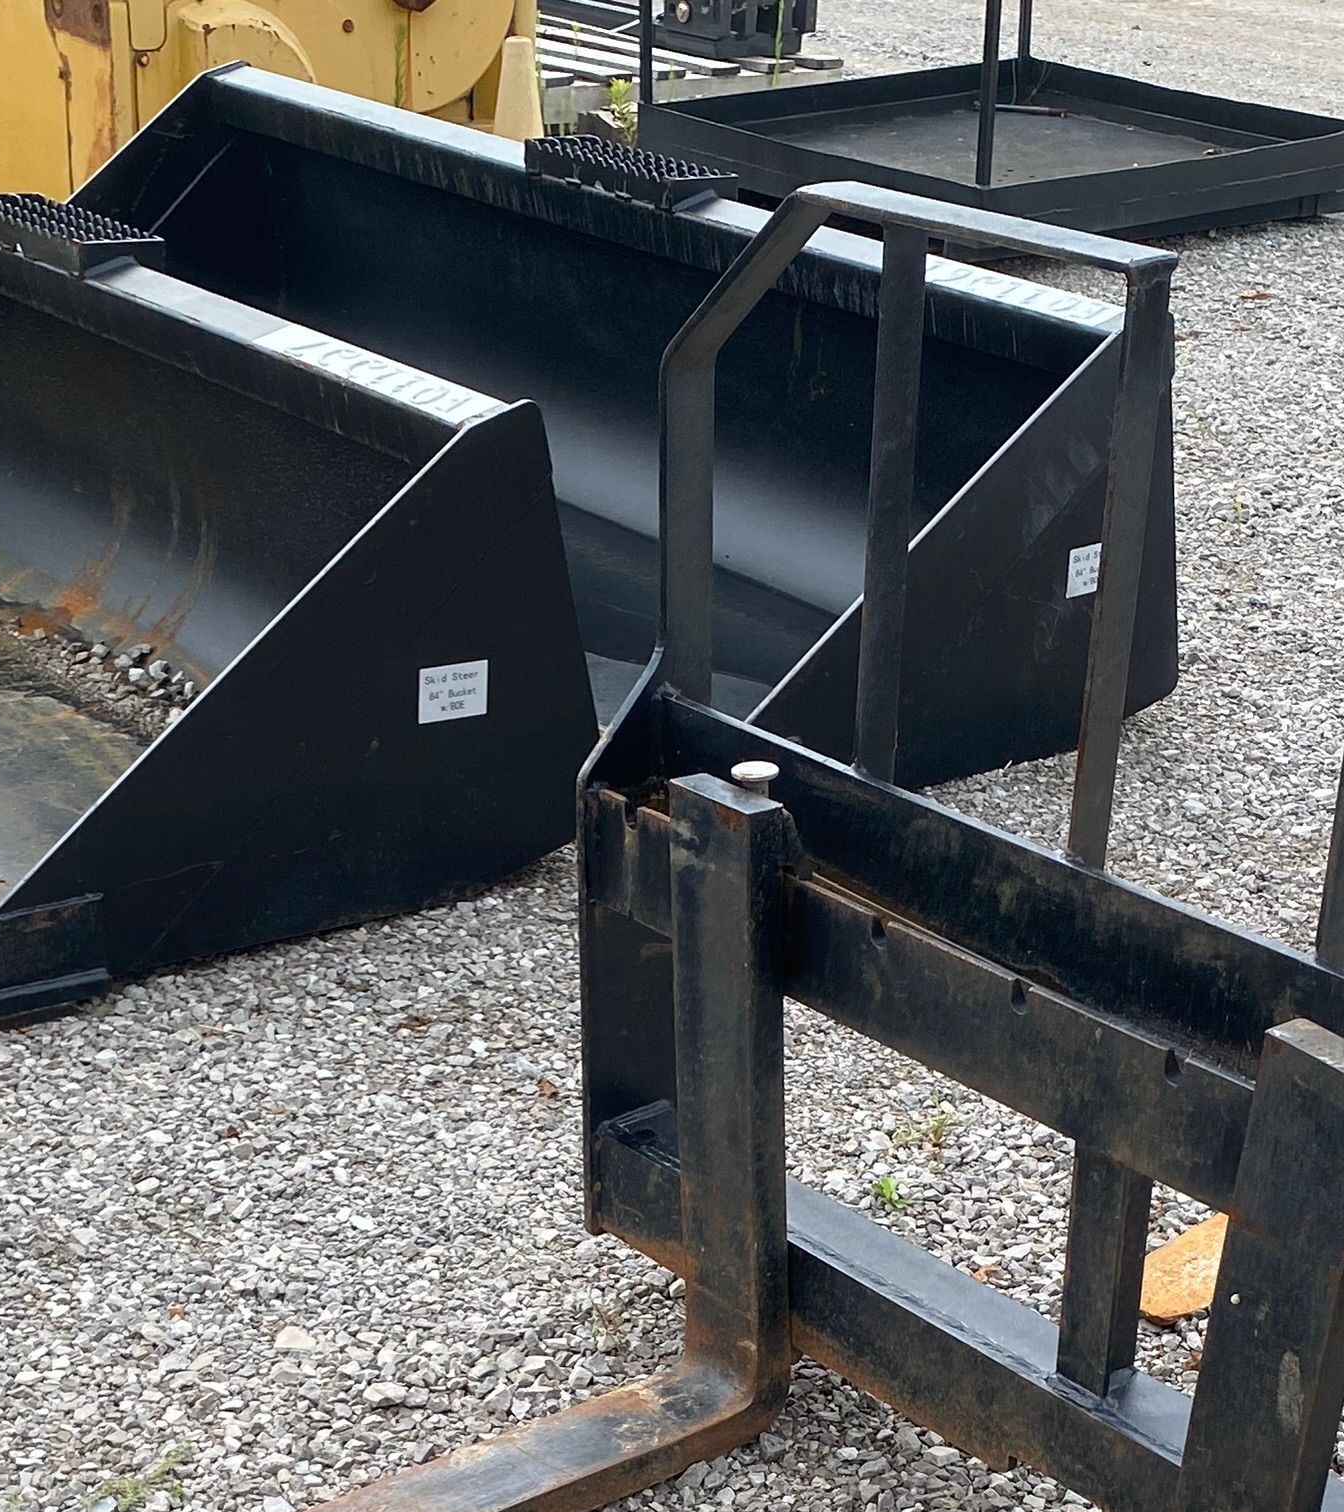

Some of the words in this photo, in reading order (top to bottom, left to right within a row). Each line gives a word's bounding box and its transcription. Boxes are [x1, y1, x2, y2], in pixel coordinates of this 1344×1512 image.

[424, 674, 448, 686] Skid
[451, 671, 479, 681] Steer
[428, 690, 444, 701] 84"
[447, 687, 477, 699] Bucket
